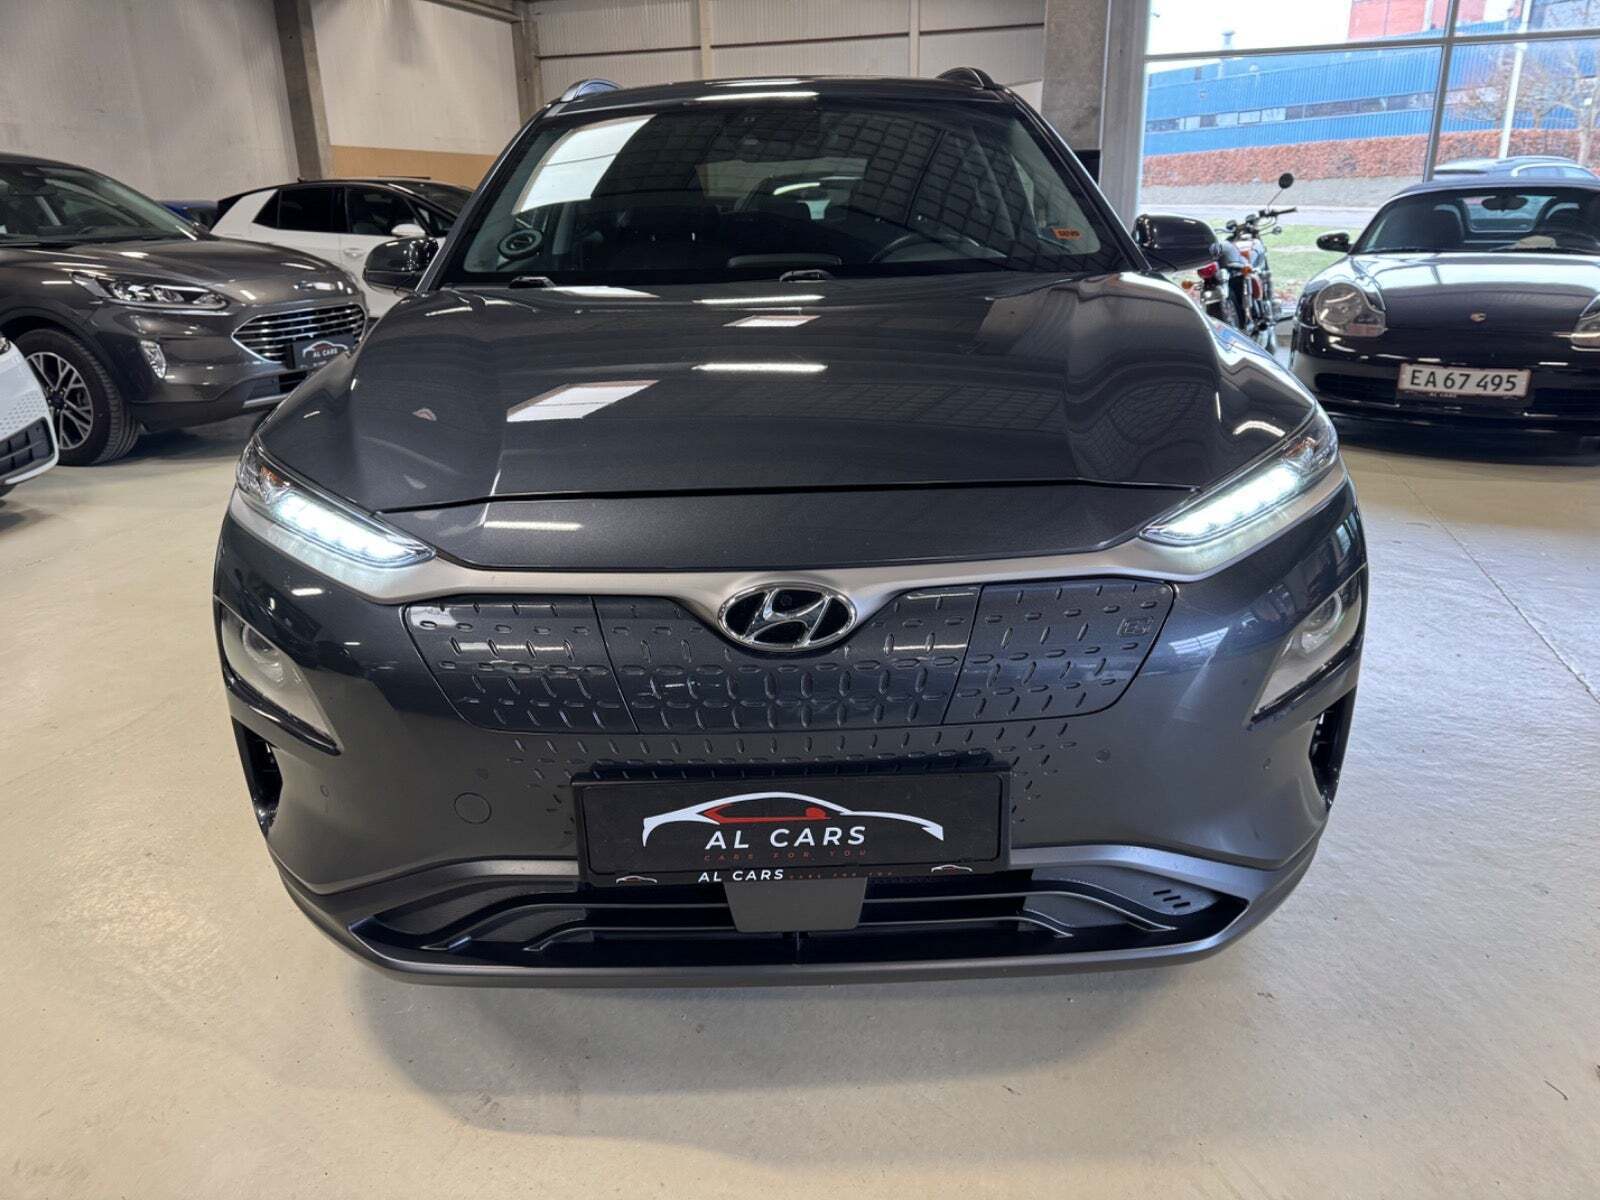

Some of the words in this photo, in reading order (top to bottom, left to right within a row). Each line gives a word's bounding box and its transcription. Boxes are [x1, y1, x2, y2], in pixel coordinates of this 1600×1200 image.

[1410, 369, 1437, 388] EA
[1443, 372, 1472, 390] 67
[1476, 374, 1518, 392] 495
[705, 830, 749, 850] AL
[770, 826, 866, 848] CARS
[703, 852, 754, 862] CARS
[772, 851, 811, 859] FOR
[829, 849, 867, 858] YOU
[698, 871, 723, 883] AL
[732, 868, 785, 881] CARS
